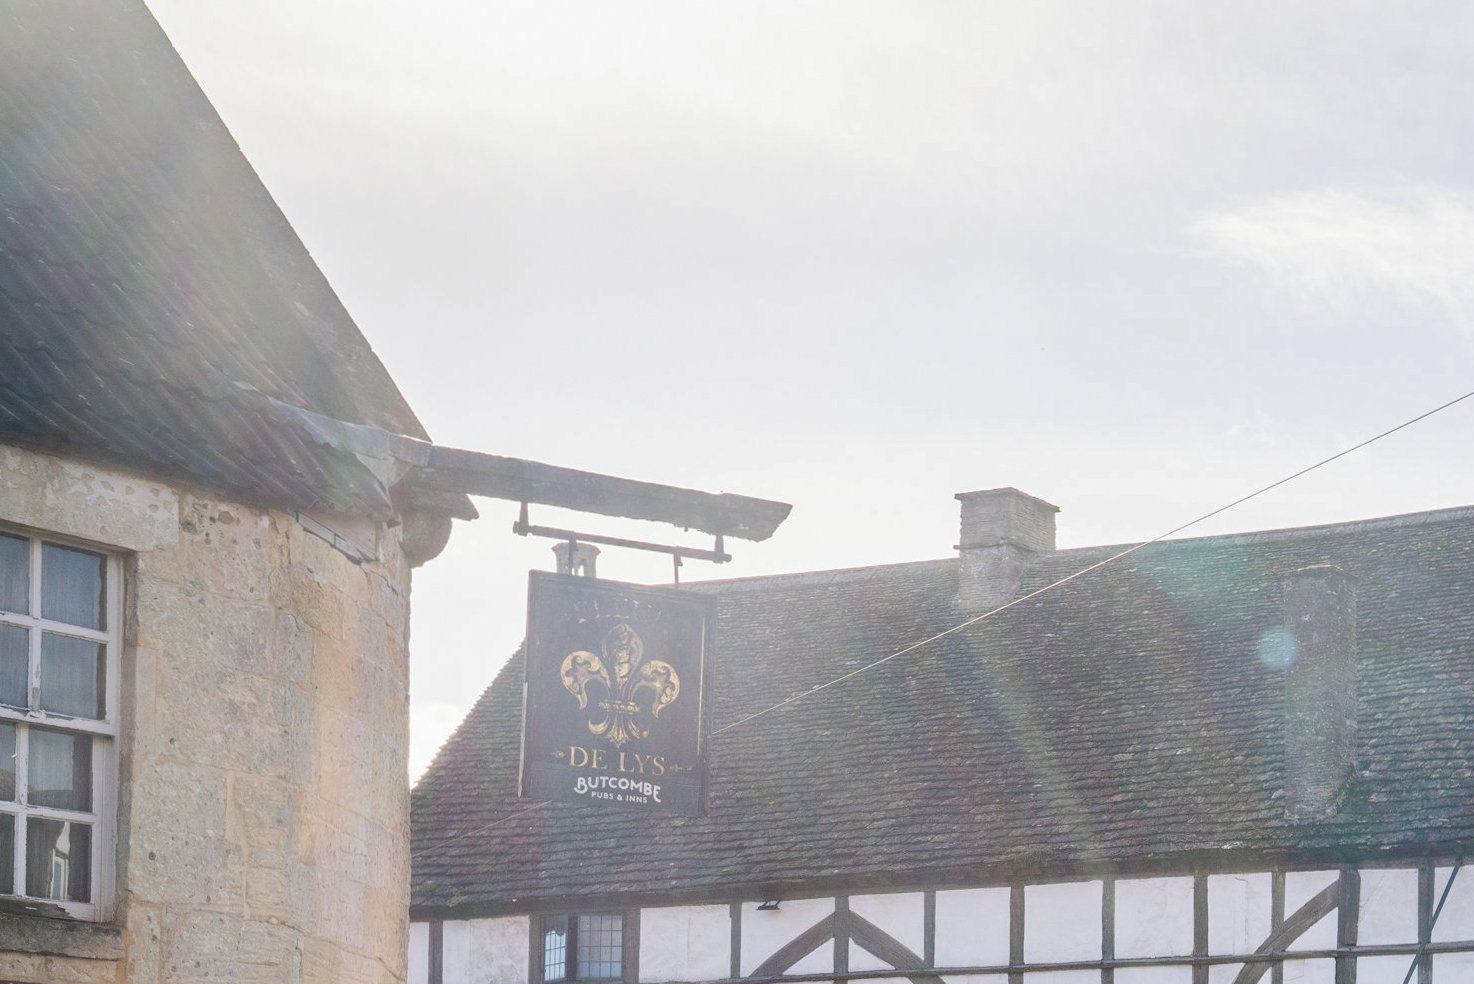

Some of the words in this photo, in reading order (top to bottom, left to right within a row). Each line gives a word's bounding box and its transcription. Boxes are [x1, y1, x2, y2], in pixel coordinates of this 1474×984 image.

[568, 746, 608, 770] DE
[617, 751, 665, 777] LYS
[573, 776, 662, 803] BUTCOMBE
[591, 791, 614, 801] PUBS
[626, 794, 648, 804] INNS
